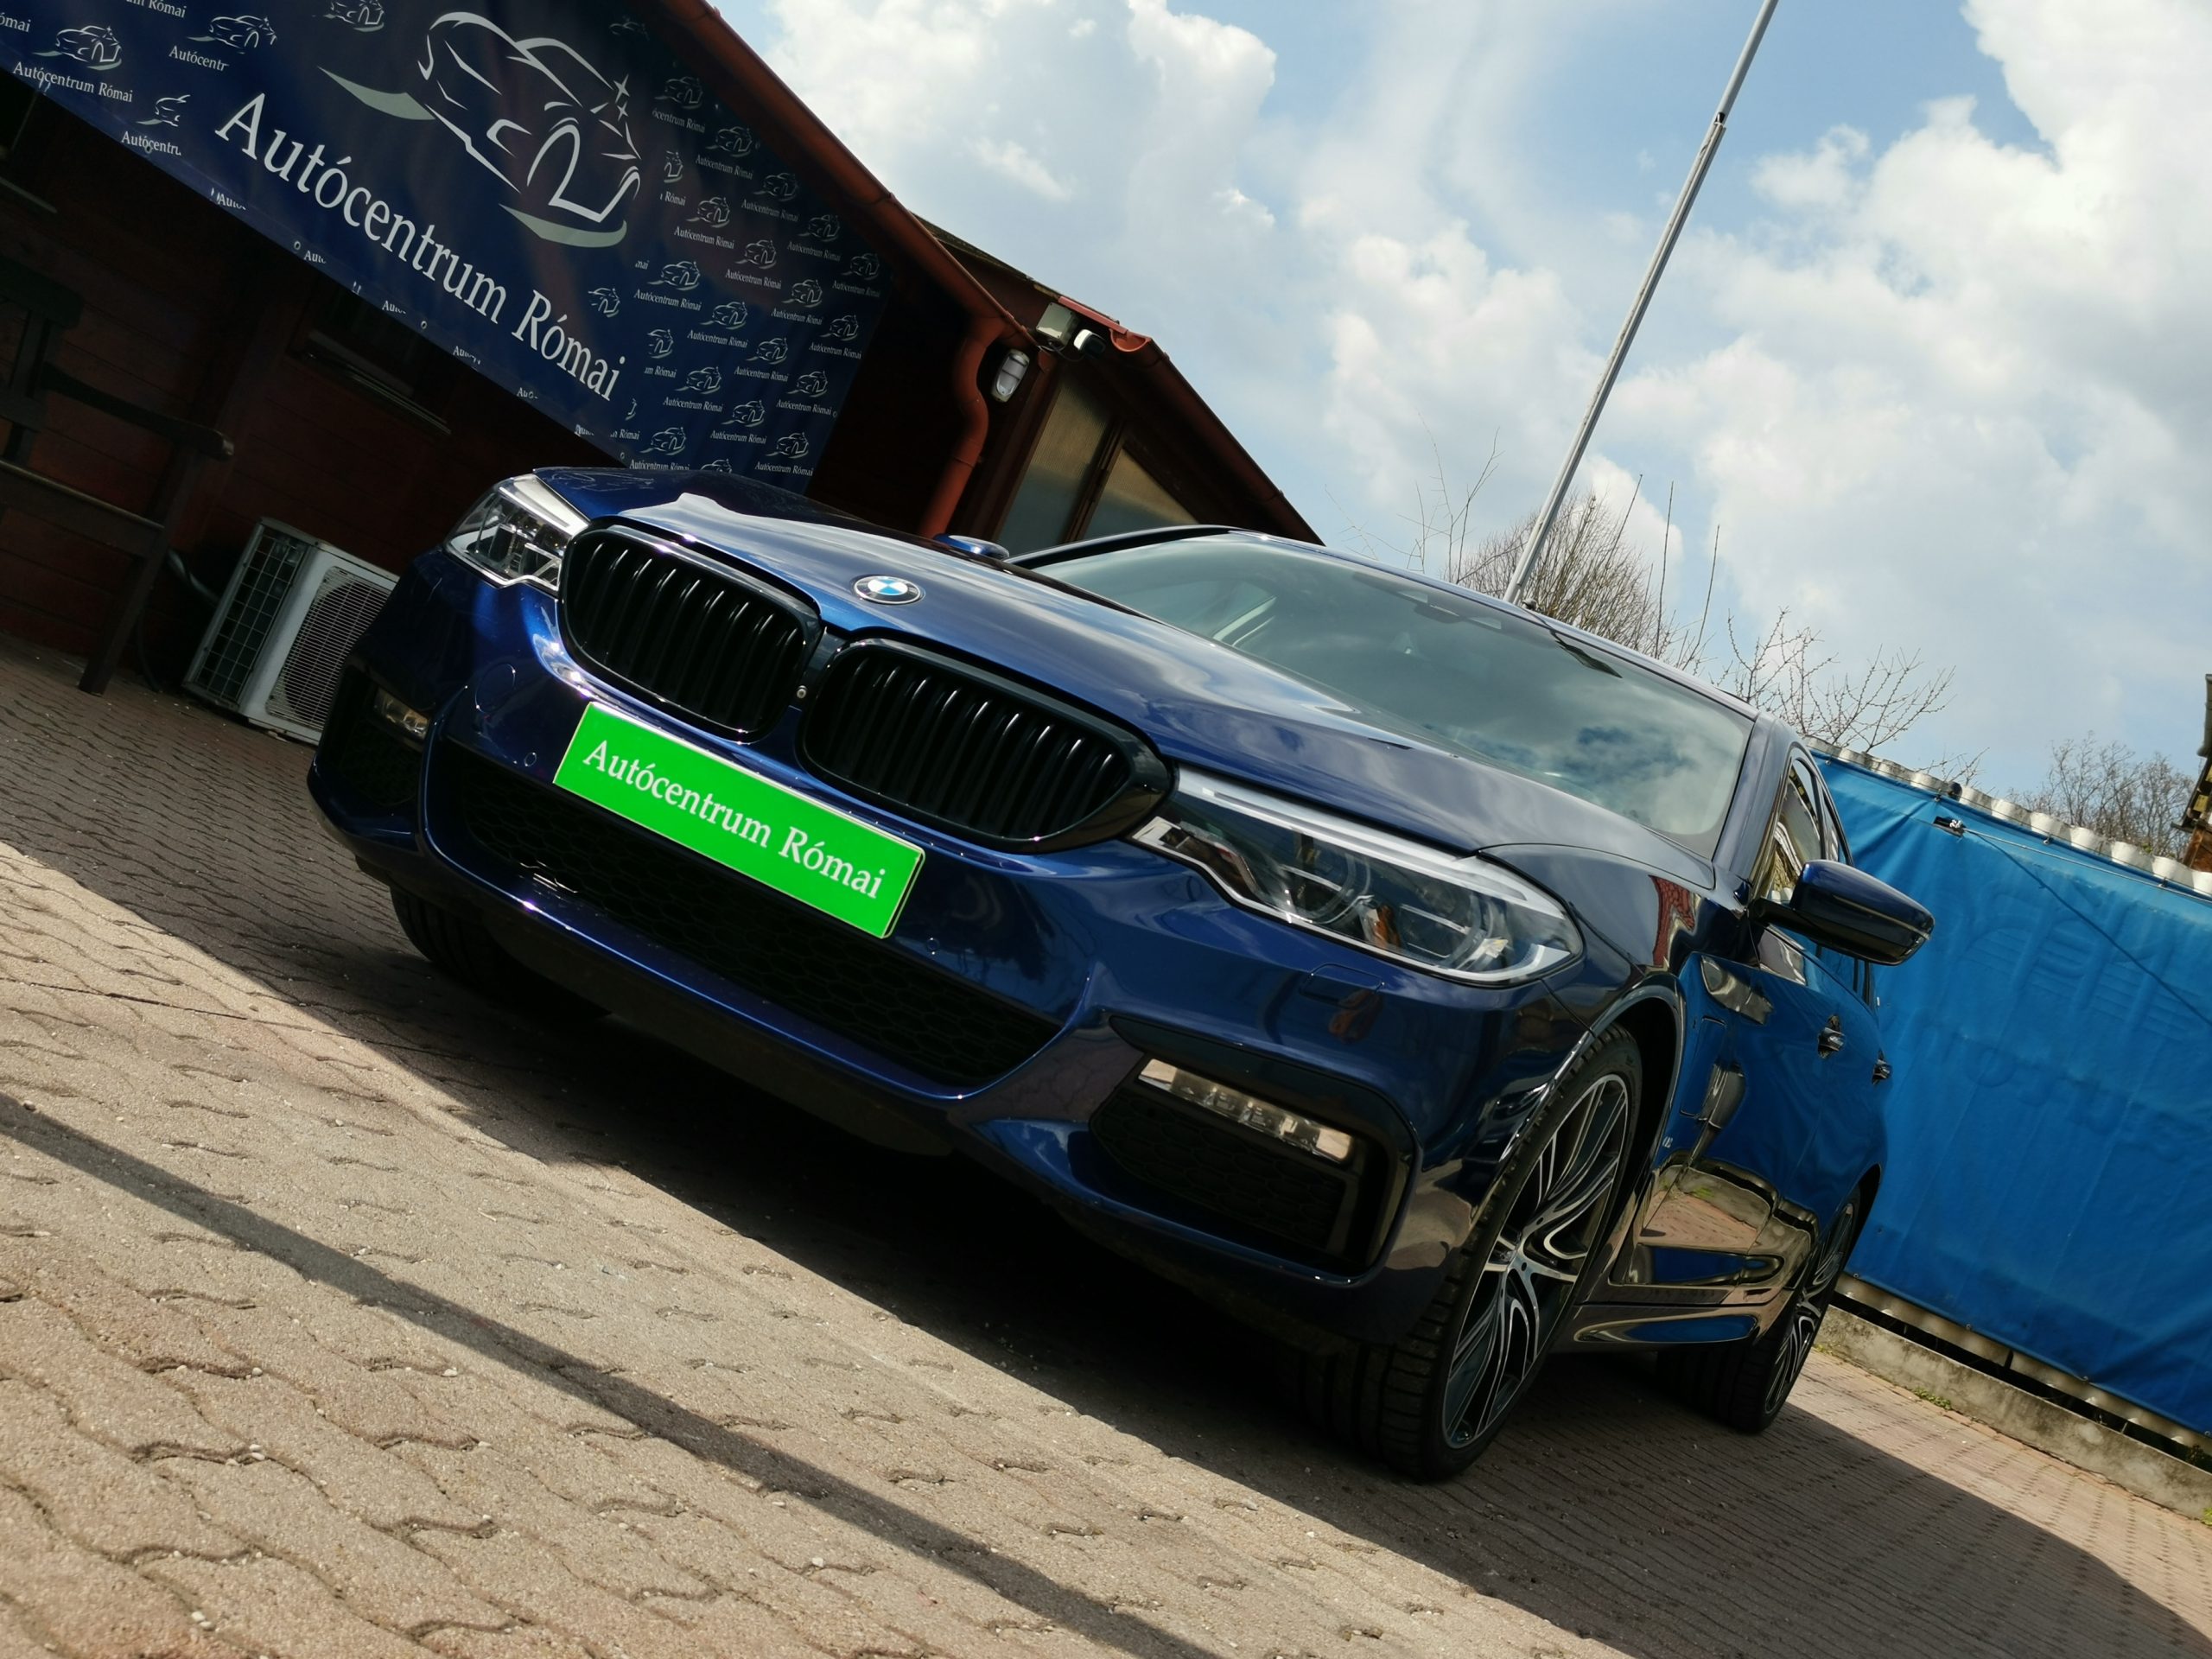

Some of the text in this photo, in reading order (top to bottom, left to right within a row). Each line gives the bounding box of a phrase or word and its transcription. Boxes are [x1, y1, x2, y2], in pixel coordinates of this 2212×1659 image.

[13, 61, 133, 103] Autócentrum Római
[696, 154, 734, 174] Autócentrum
[664, 190, 687, 207] Római
[214, 92, 626, 402] Autócentrum Római
[674, 226, 735, 250] Autócentrum Római
[725, 269, 782, 290] Autócentrum Római
[633, 288, 702, 312] Autócentrum Római
[687, 329, 749, 348] Autócentrum Római
[654, 365, 677, 378] Római
[734, 365, 770, 379] Autócentrum
[663, 396, 724, 413] Autócentrum Római
[775, 398, 833, 416] Autócentrum Római
[619, 429, 640, 441] Római
[709, 429, 767, 445] Autócentrum Római
[754, 461, 815, 477] Autócentrum Római
[582, 739, 887, 899] Autócentrum Római
